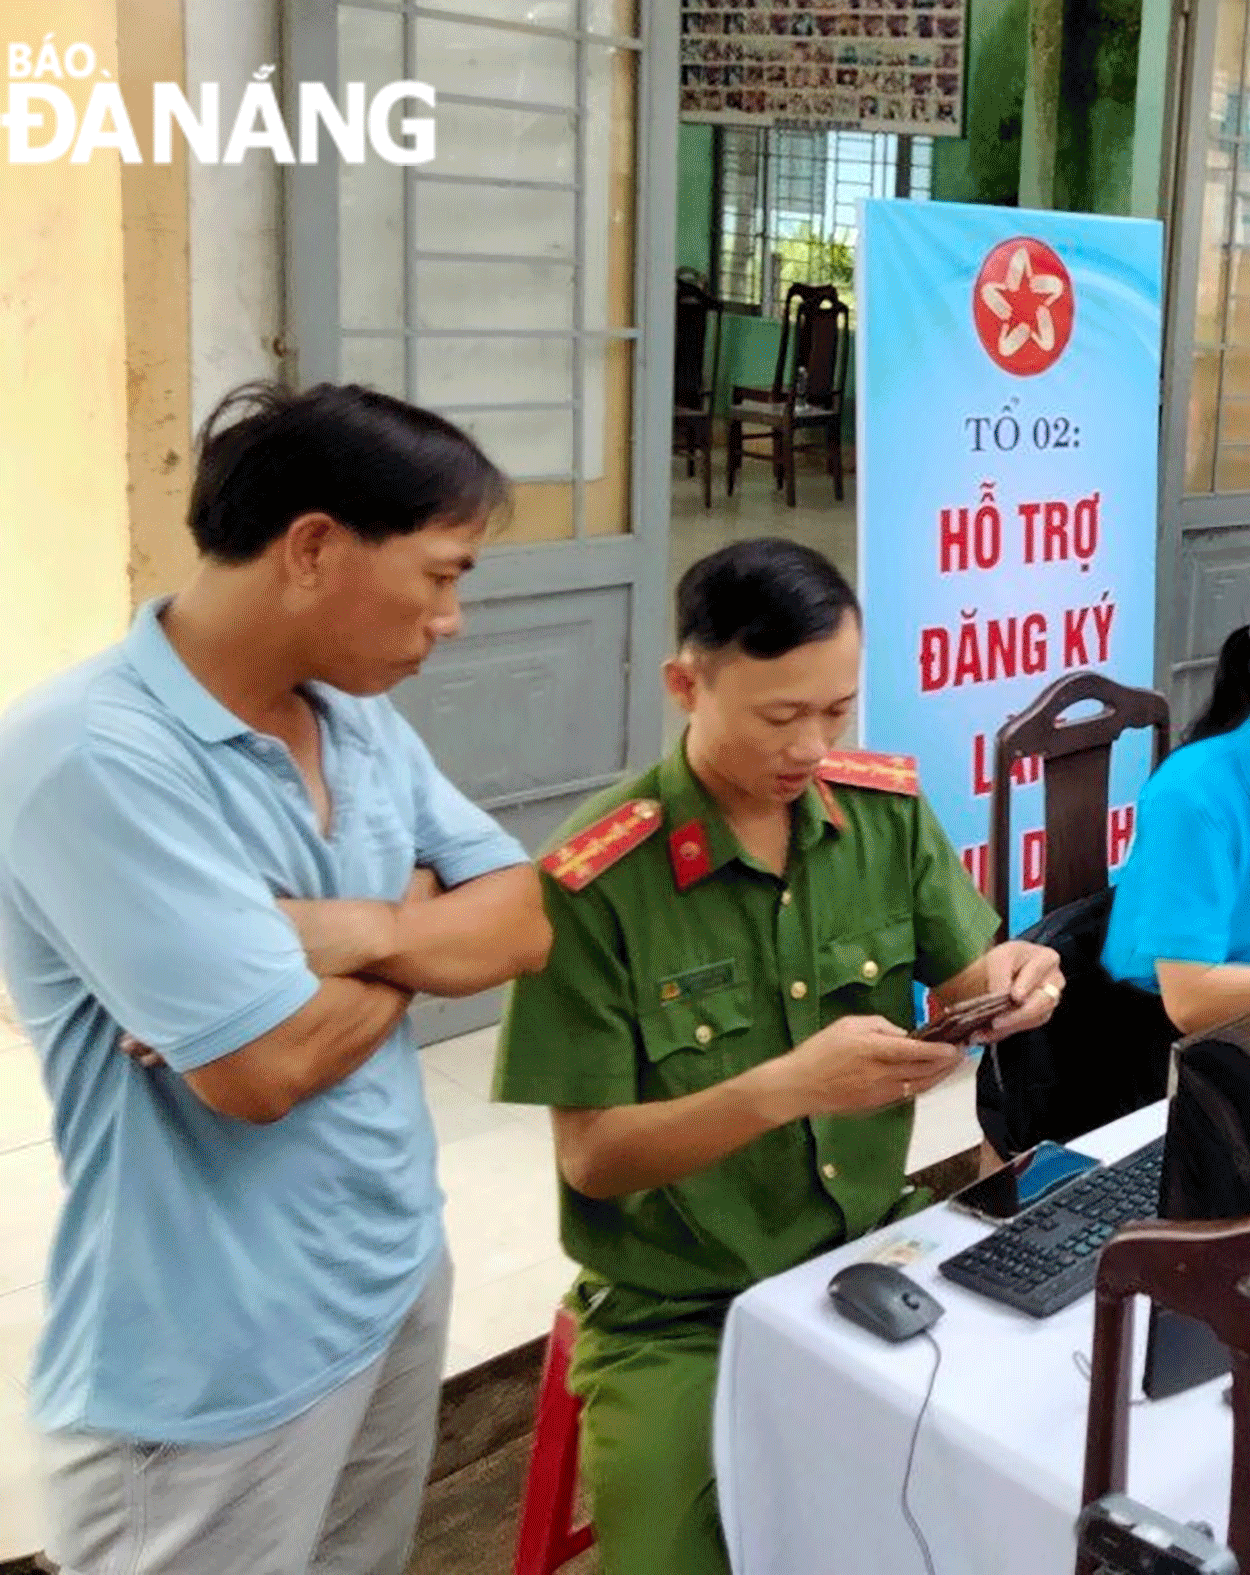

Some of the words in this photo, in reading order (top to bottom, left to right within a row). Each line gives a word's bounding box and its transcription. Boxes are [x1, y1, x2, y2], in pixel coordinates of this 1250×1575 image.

[965, 397, 1020, 451] TỔ
[1033, 417, 1080, 449] 02:
[940, 481, 1000, 573] HỖ
[1018, 492, 1100, 572] TRỢ
[920, 607, 1048, 692] ĐĂNG
[1064, 591, 1115, 668] KÝ
